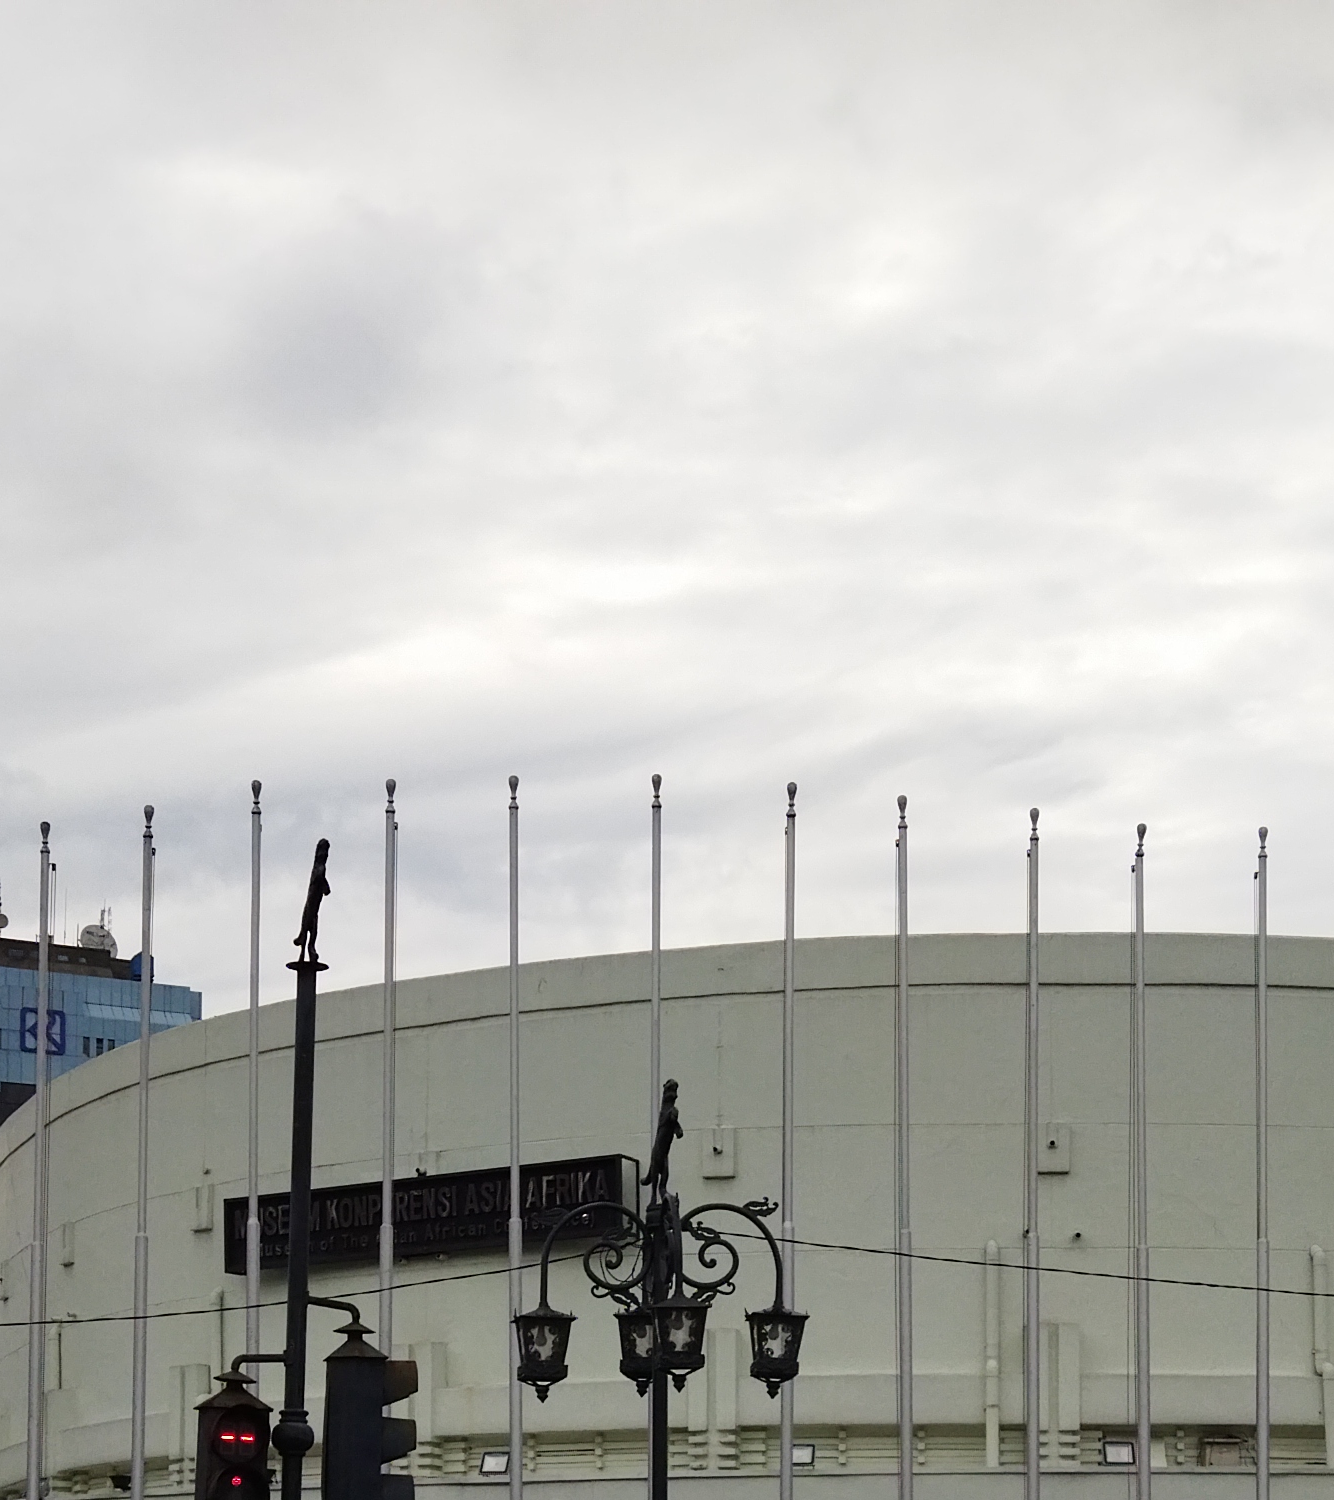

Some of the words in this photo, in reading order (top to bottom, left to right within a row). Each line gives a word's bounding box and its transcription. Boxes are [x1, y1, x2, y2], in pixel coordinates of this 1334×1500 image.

[327, 1186, 458, 1229] KONPRENSI
[525, 1169, 610, 1209] AFRIKA
[342, 1231, 369, 1249] The
[424, 1219, 487, 1241] African
